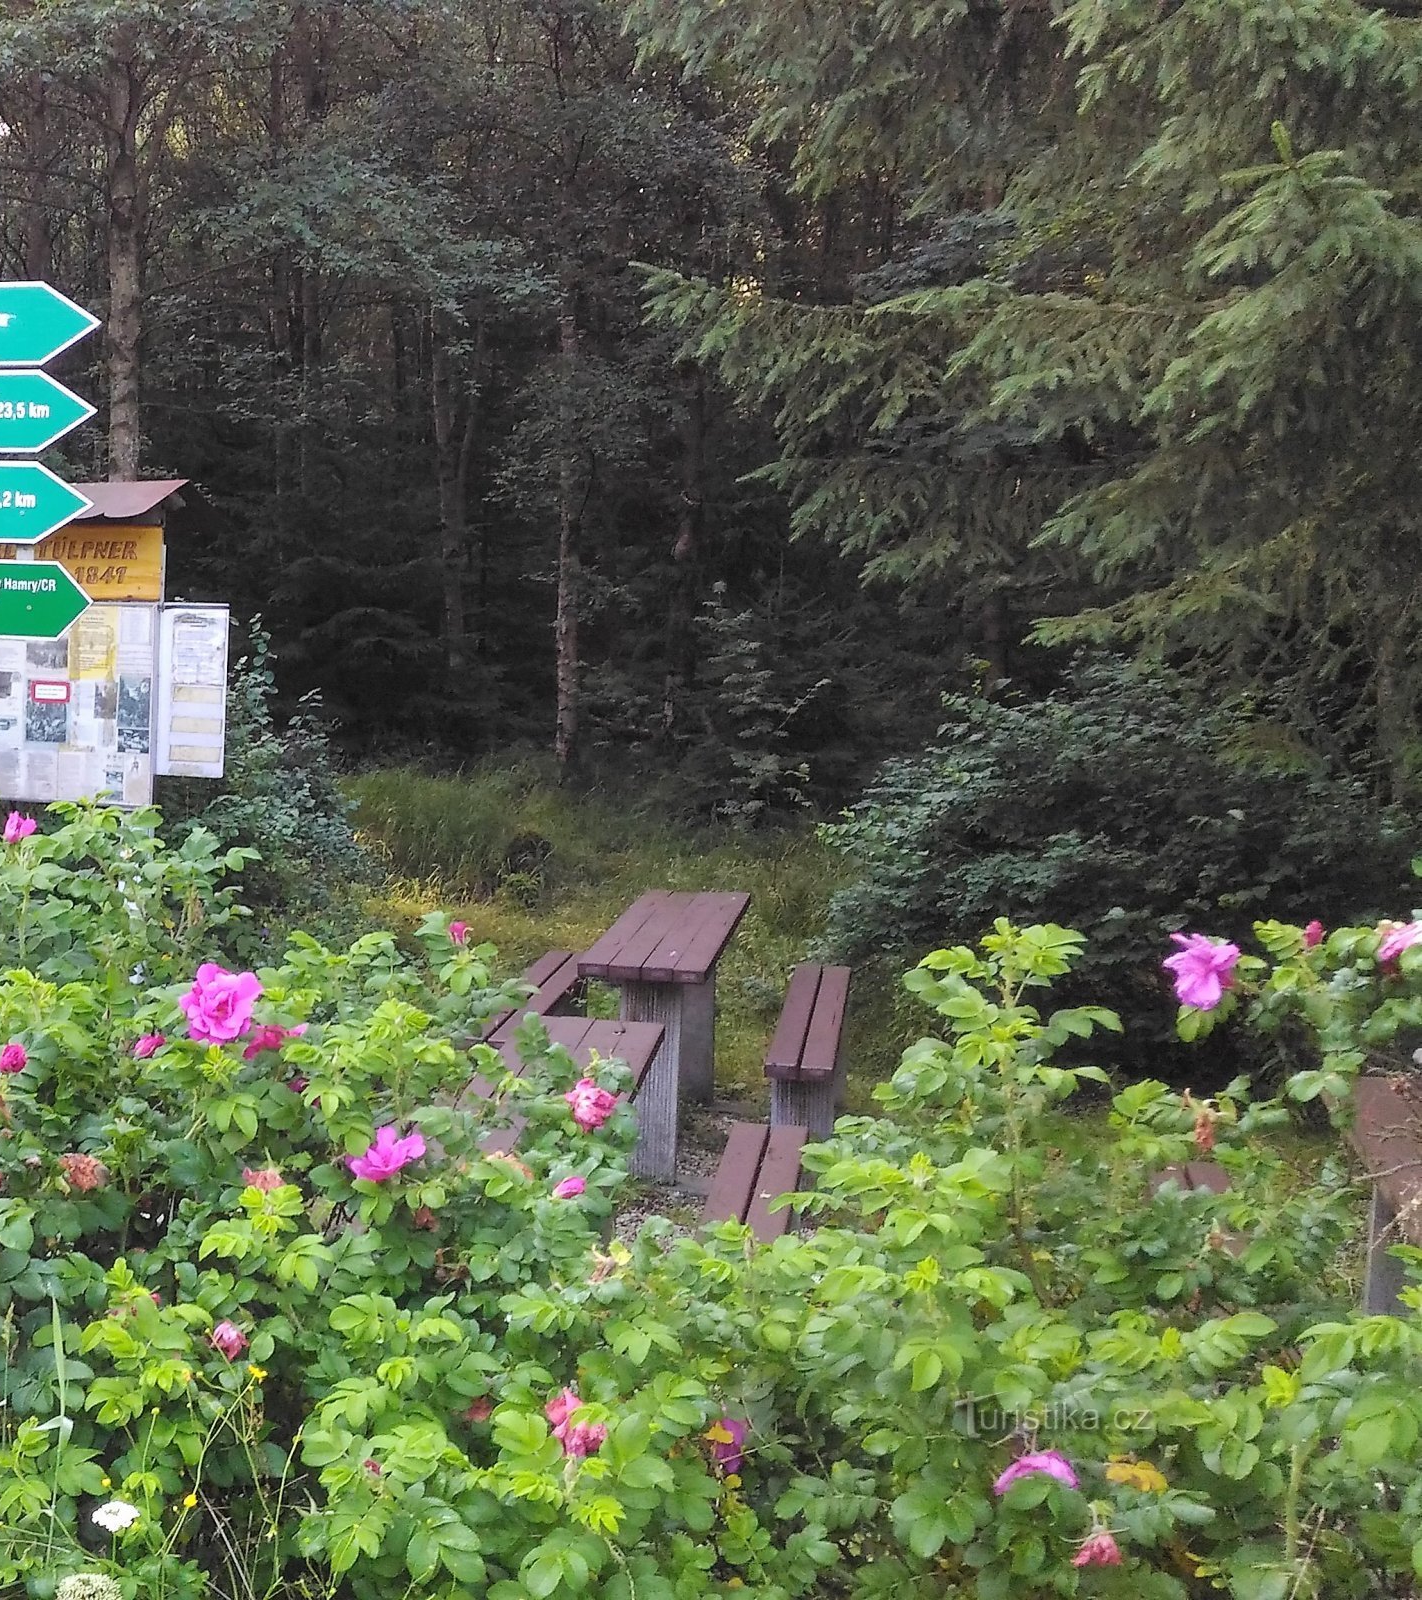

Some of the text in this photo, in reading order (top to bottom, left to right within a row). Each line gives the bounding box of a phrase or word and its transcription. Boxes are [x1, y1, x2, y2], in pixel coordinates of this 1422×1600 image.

[28, 402, 50, 418] km
[15, 490, 36, 508] km
[3, 577, 57, 593] Hamry/CR
